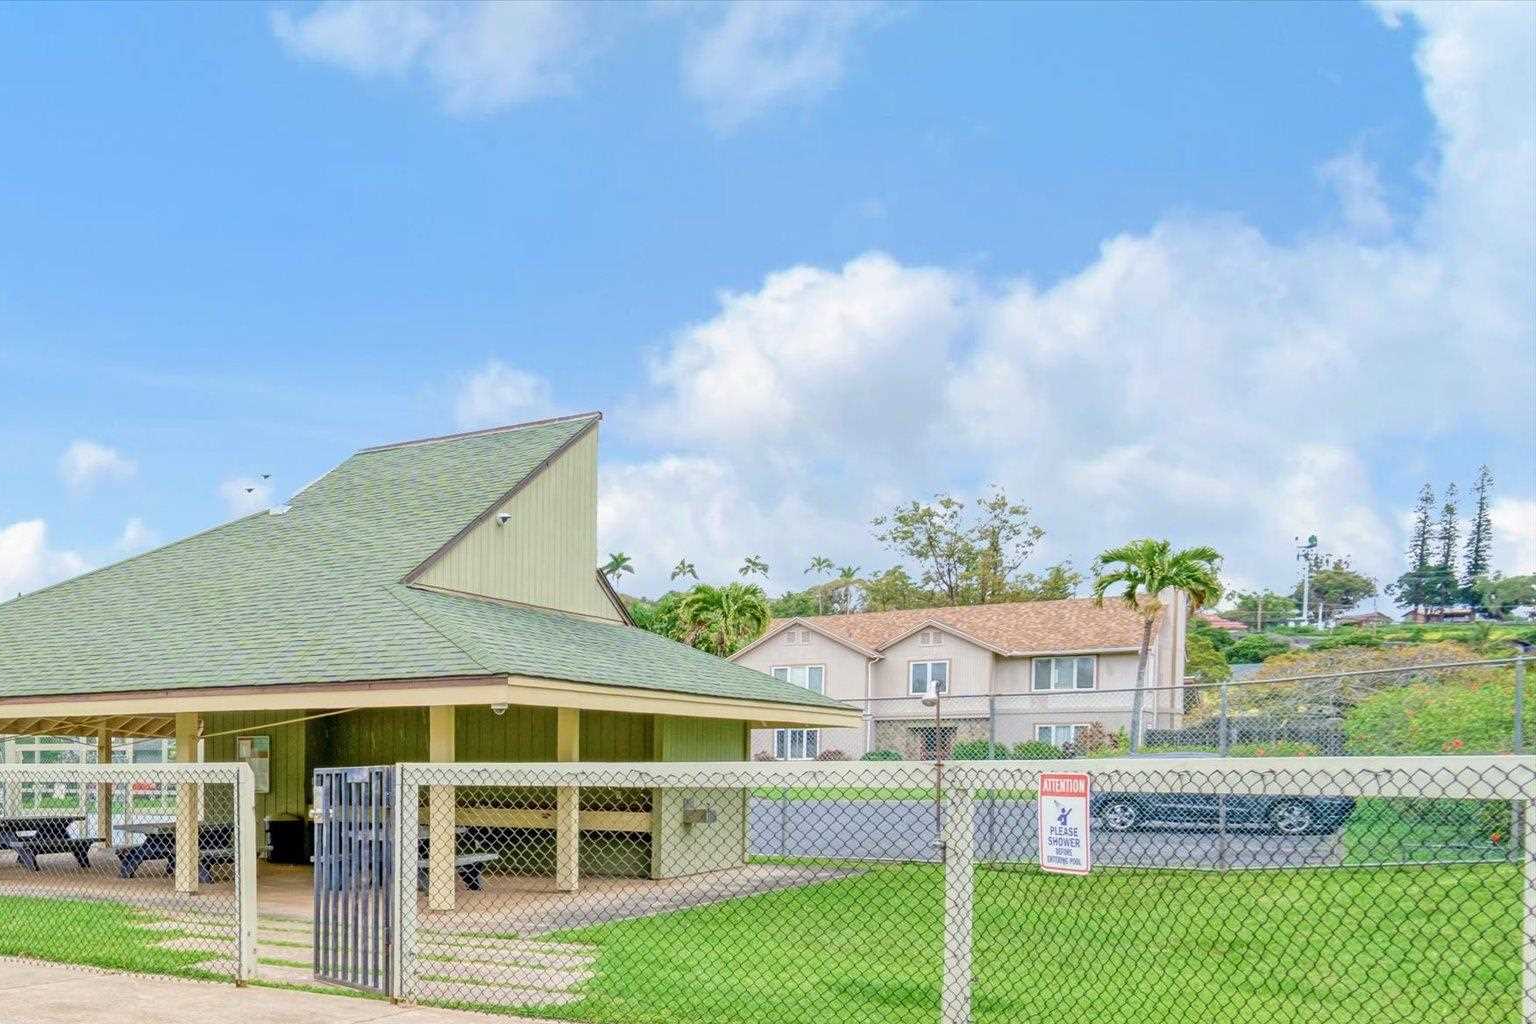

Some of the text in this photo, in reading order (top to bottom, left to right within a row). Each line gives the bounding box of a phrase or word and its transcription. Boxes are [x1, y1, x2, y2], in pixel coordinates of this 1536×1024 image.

[1043, 778, 1086, 793] ATTENTION
[1050, 826, 1078, 837] PLEASE
[1048, 836, 1080, 848] SHOWER
